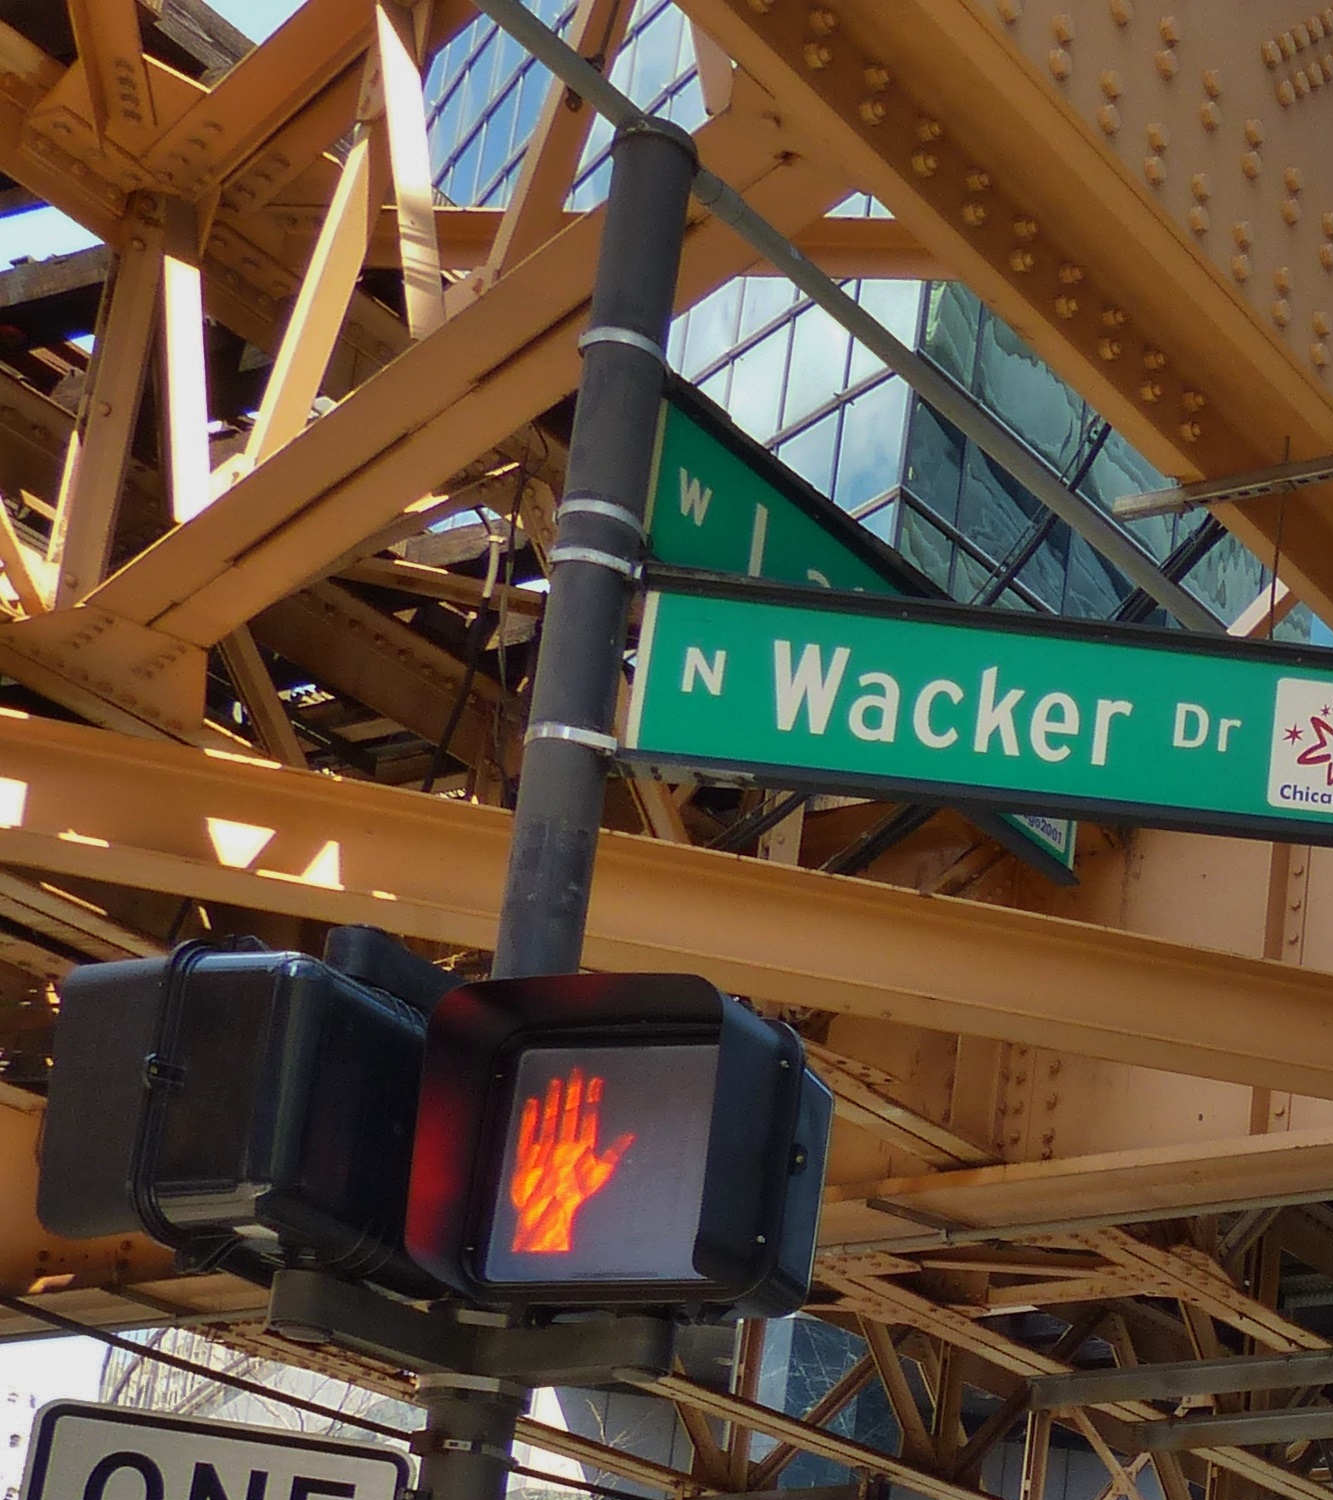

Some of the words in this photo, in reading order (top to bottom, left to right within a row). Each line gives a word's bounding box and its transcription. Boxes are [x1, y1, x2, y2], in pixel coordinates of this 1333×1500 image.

[680, 467, 713, 527] W
[681, 648, 727, 697] N
[774, 639, 1132, 766] Wacker
[1173, 704, 1242, 753] Dr
